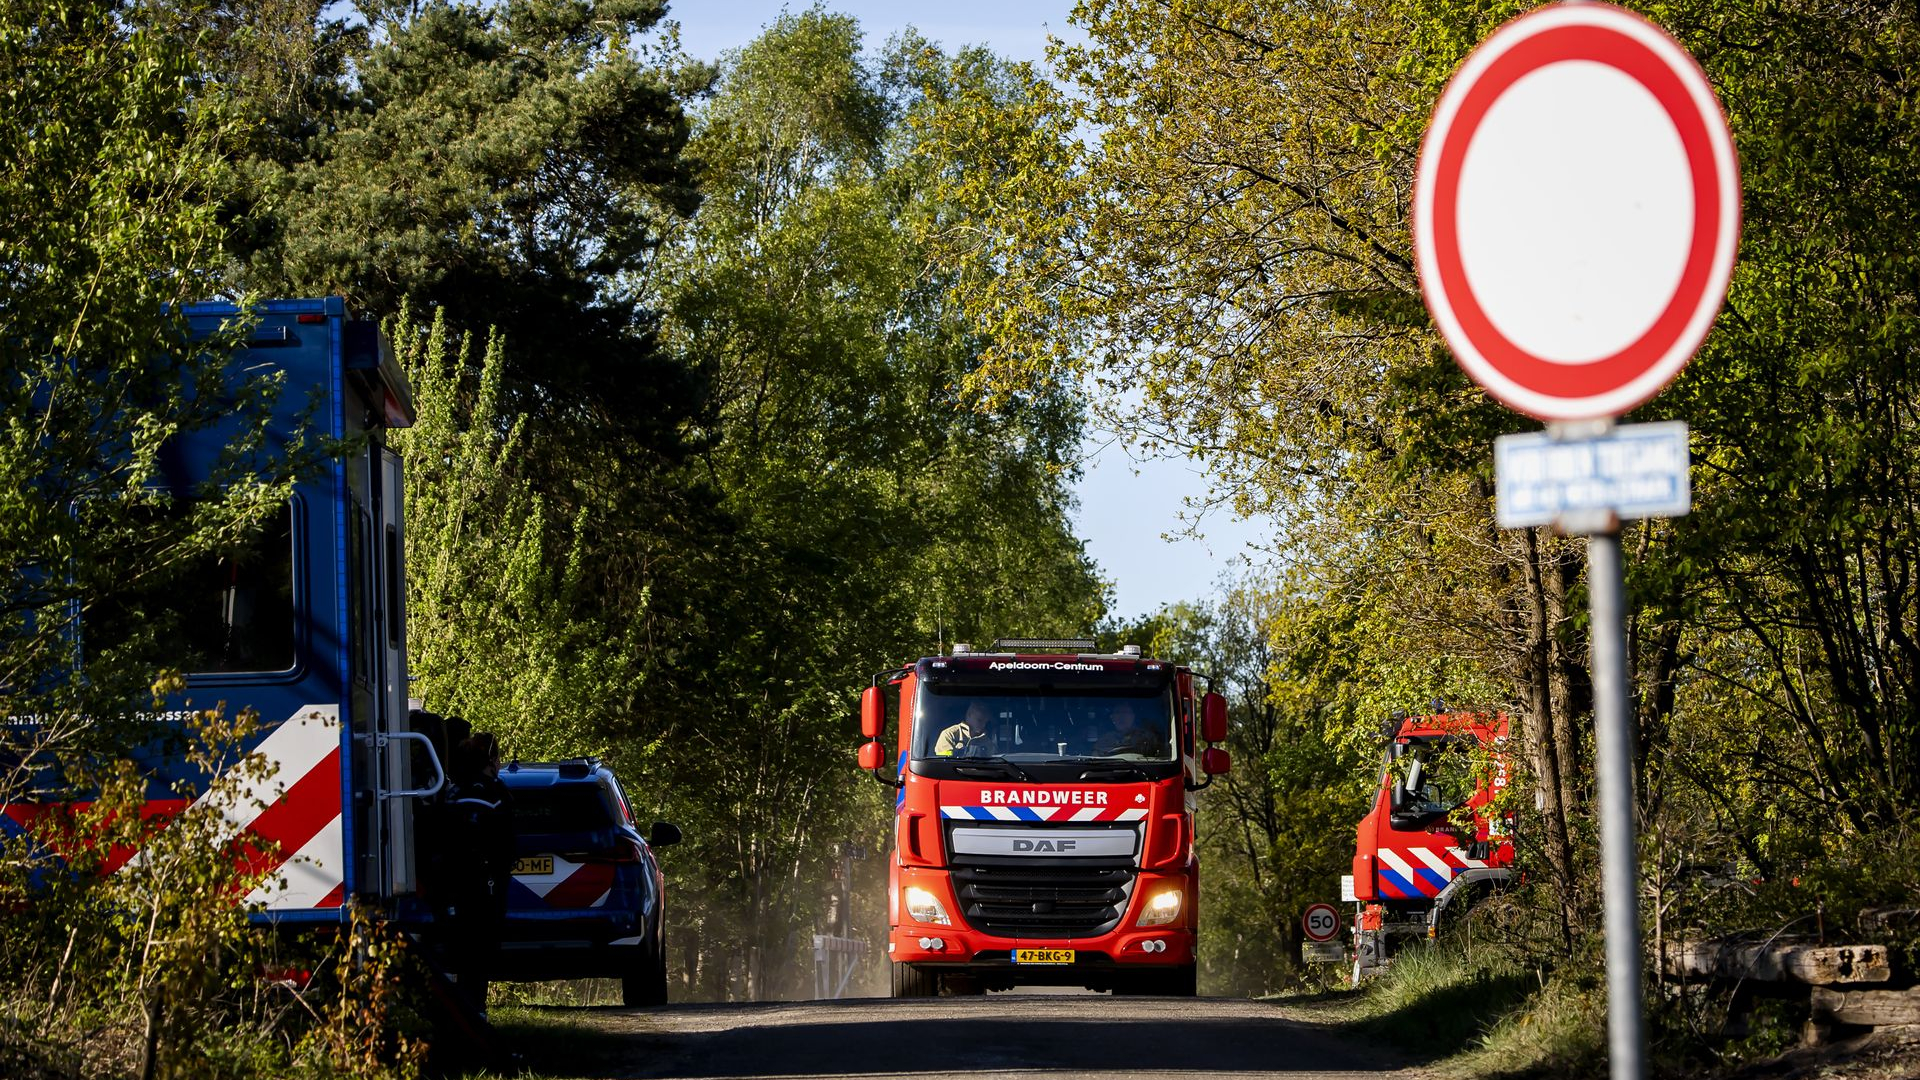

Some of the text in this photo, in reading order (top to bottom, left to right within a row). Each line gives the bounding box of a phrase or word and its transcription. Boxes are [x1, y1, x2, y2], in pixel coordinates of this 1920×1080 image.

[989, 661, 1104, 671] Apeldoorn-Centrum
[980, 790, 1108, 804] BRANDWEER
[1013, 840, 1076, 852] DAF
[1310, 916, 1334, 929] 50
[1020, 951, 1071, 961] 47-BKG-9
